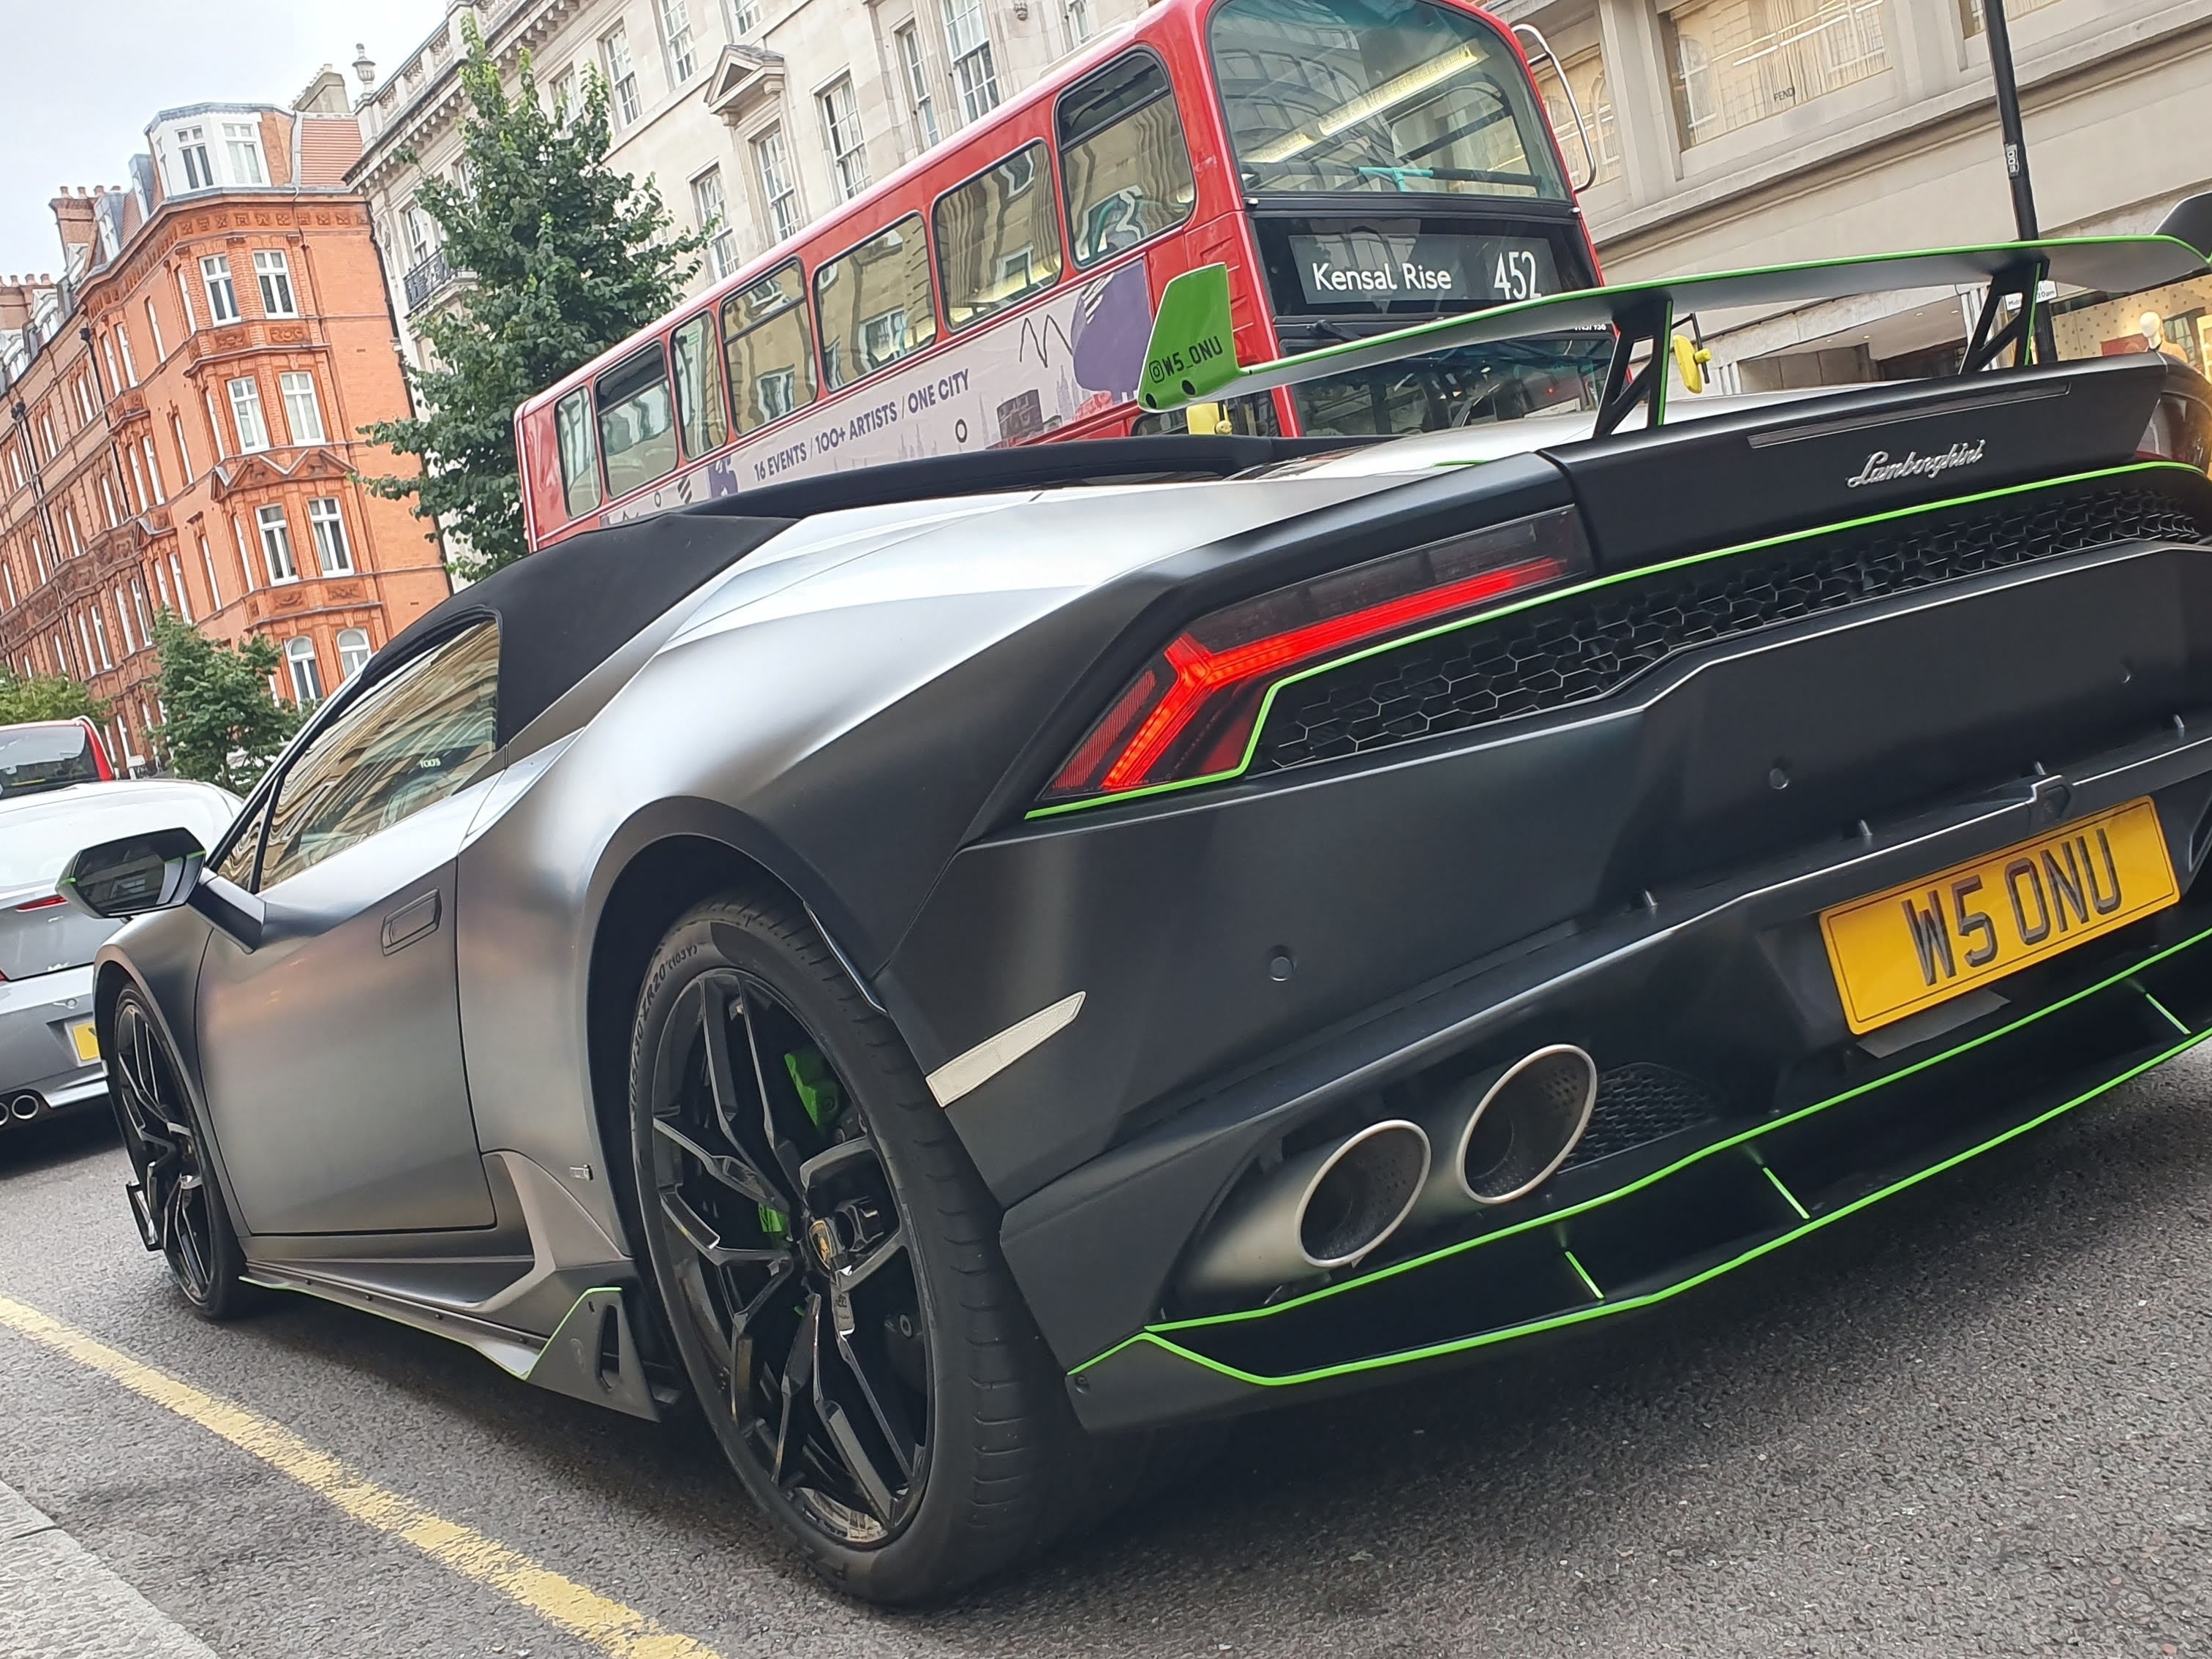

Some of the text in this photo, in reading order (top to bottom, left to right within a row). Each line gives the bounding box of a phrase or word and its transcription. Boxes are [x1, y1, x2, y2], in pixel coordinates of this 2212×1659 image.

[1312, 251, 1541, 300] Kensal Rise 452
[1162, 336, 1223, 377] W5_ONU
[753, 462, 766, 481] 16
[767, 442, 807, 476] EVENTS
[816, 426, 846, 454] 100+
[849, 402, 898, 440] ARTISTS
[908, 384, 936, 414] ONE
[938, 368, 969, 400] CITY
[1847, 439, 1986, 488] Lamborghini
[1901, 828, 2122, 987] W5 ONU
